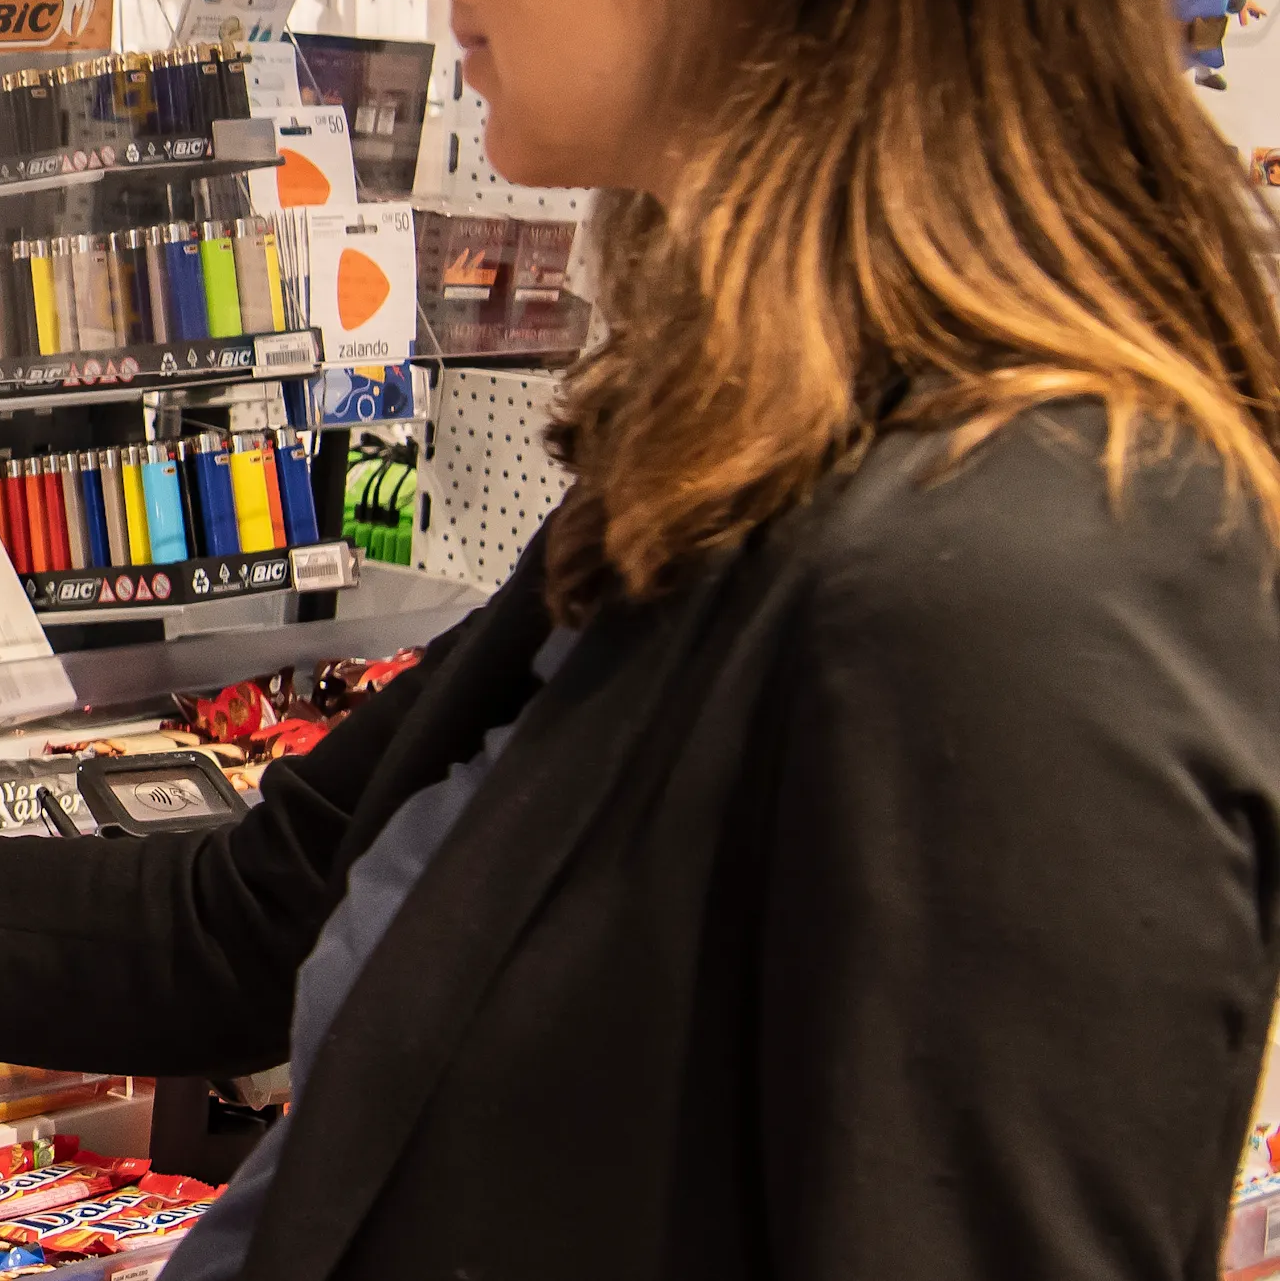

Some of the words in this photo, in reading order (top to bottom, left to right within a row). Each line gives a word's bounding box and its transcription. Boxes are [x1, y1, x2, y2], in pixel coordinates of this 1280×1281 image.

[329, 114, 344, 135] 50
[173, 140, 204, 158] BIC
[28, 159, 58, 176] BIC
[394, 212, 410, 233] 50
[338, 338, 389, 358] zalando
[220, 349, 252, 368] BIC
[252, 563, 286, 583] BIC
[60, 581, 95, 602] BIC
